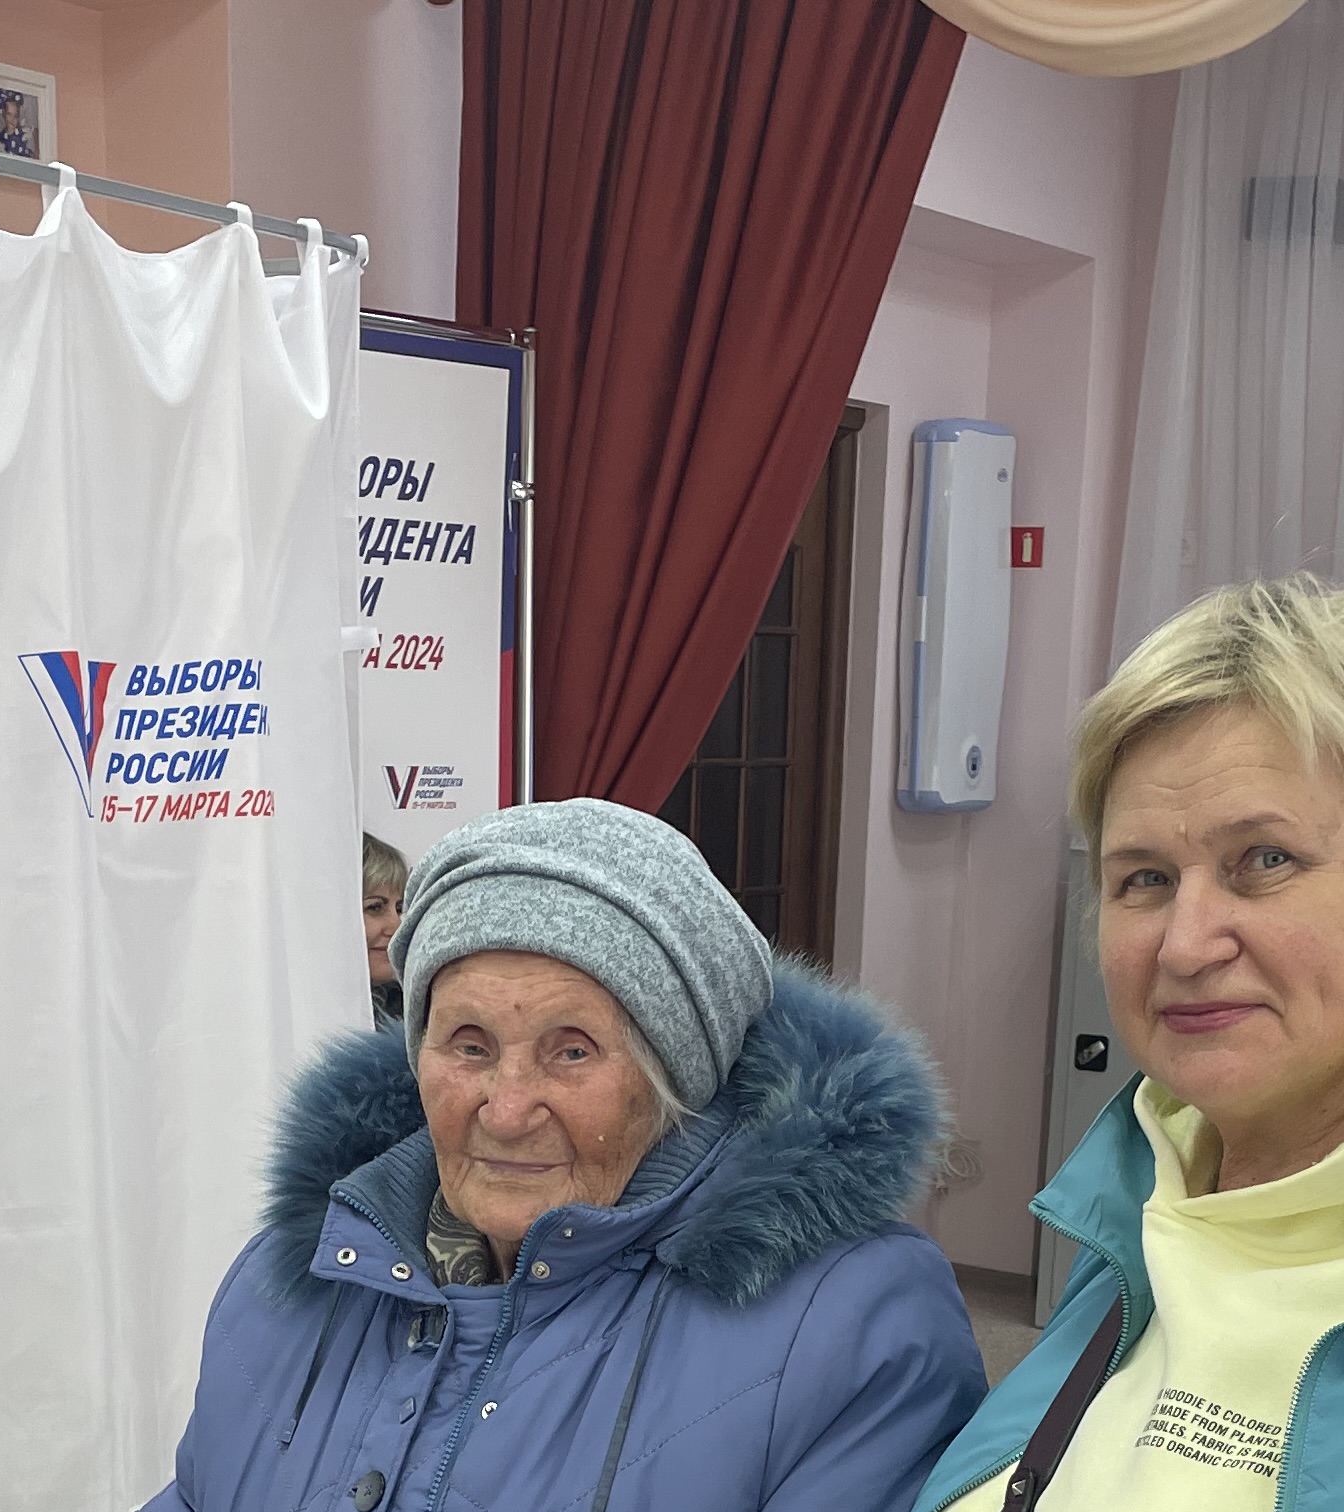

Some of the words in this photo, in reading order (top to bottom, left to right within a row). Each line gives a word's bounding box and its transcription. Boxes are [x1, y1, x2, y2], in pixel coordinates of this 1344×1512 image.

[359, 456, 435, 502] ОРЫ
[359, 516, 476, 565] ИДЕНТА
[385, 634, 444, 671] 2024
[125, 659, 261, 696] ВЫБОРЫ
[115, 703, 269, 740] ПРЕЗИДЕН
[106, 748, 229, 784] РОССИИ
[159, 791, 230, 822] МАРТА
[234, 789, 274, 817] 202
[1159, 1404, 1191, 1421] MADE
[1191, 1413, 1230, 1437] FROM
[1163, 1388, 1207, 1409] HOODIE
[1206, 1403, 1222, 1416] IS
[1222, 1410, 1282, 1436] COLORED
[1166, 1439, 1222, 1466] ORGANIC
[1222, 1458, 1275, 1478] COTTON
[1191, 1431, 1237, 1455] FABRIC
[1236, 1447, 1252, 1457] IS
[1251, 1449, 1283, 1463] MAD
